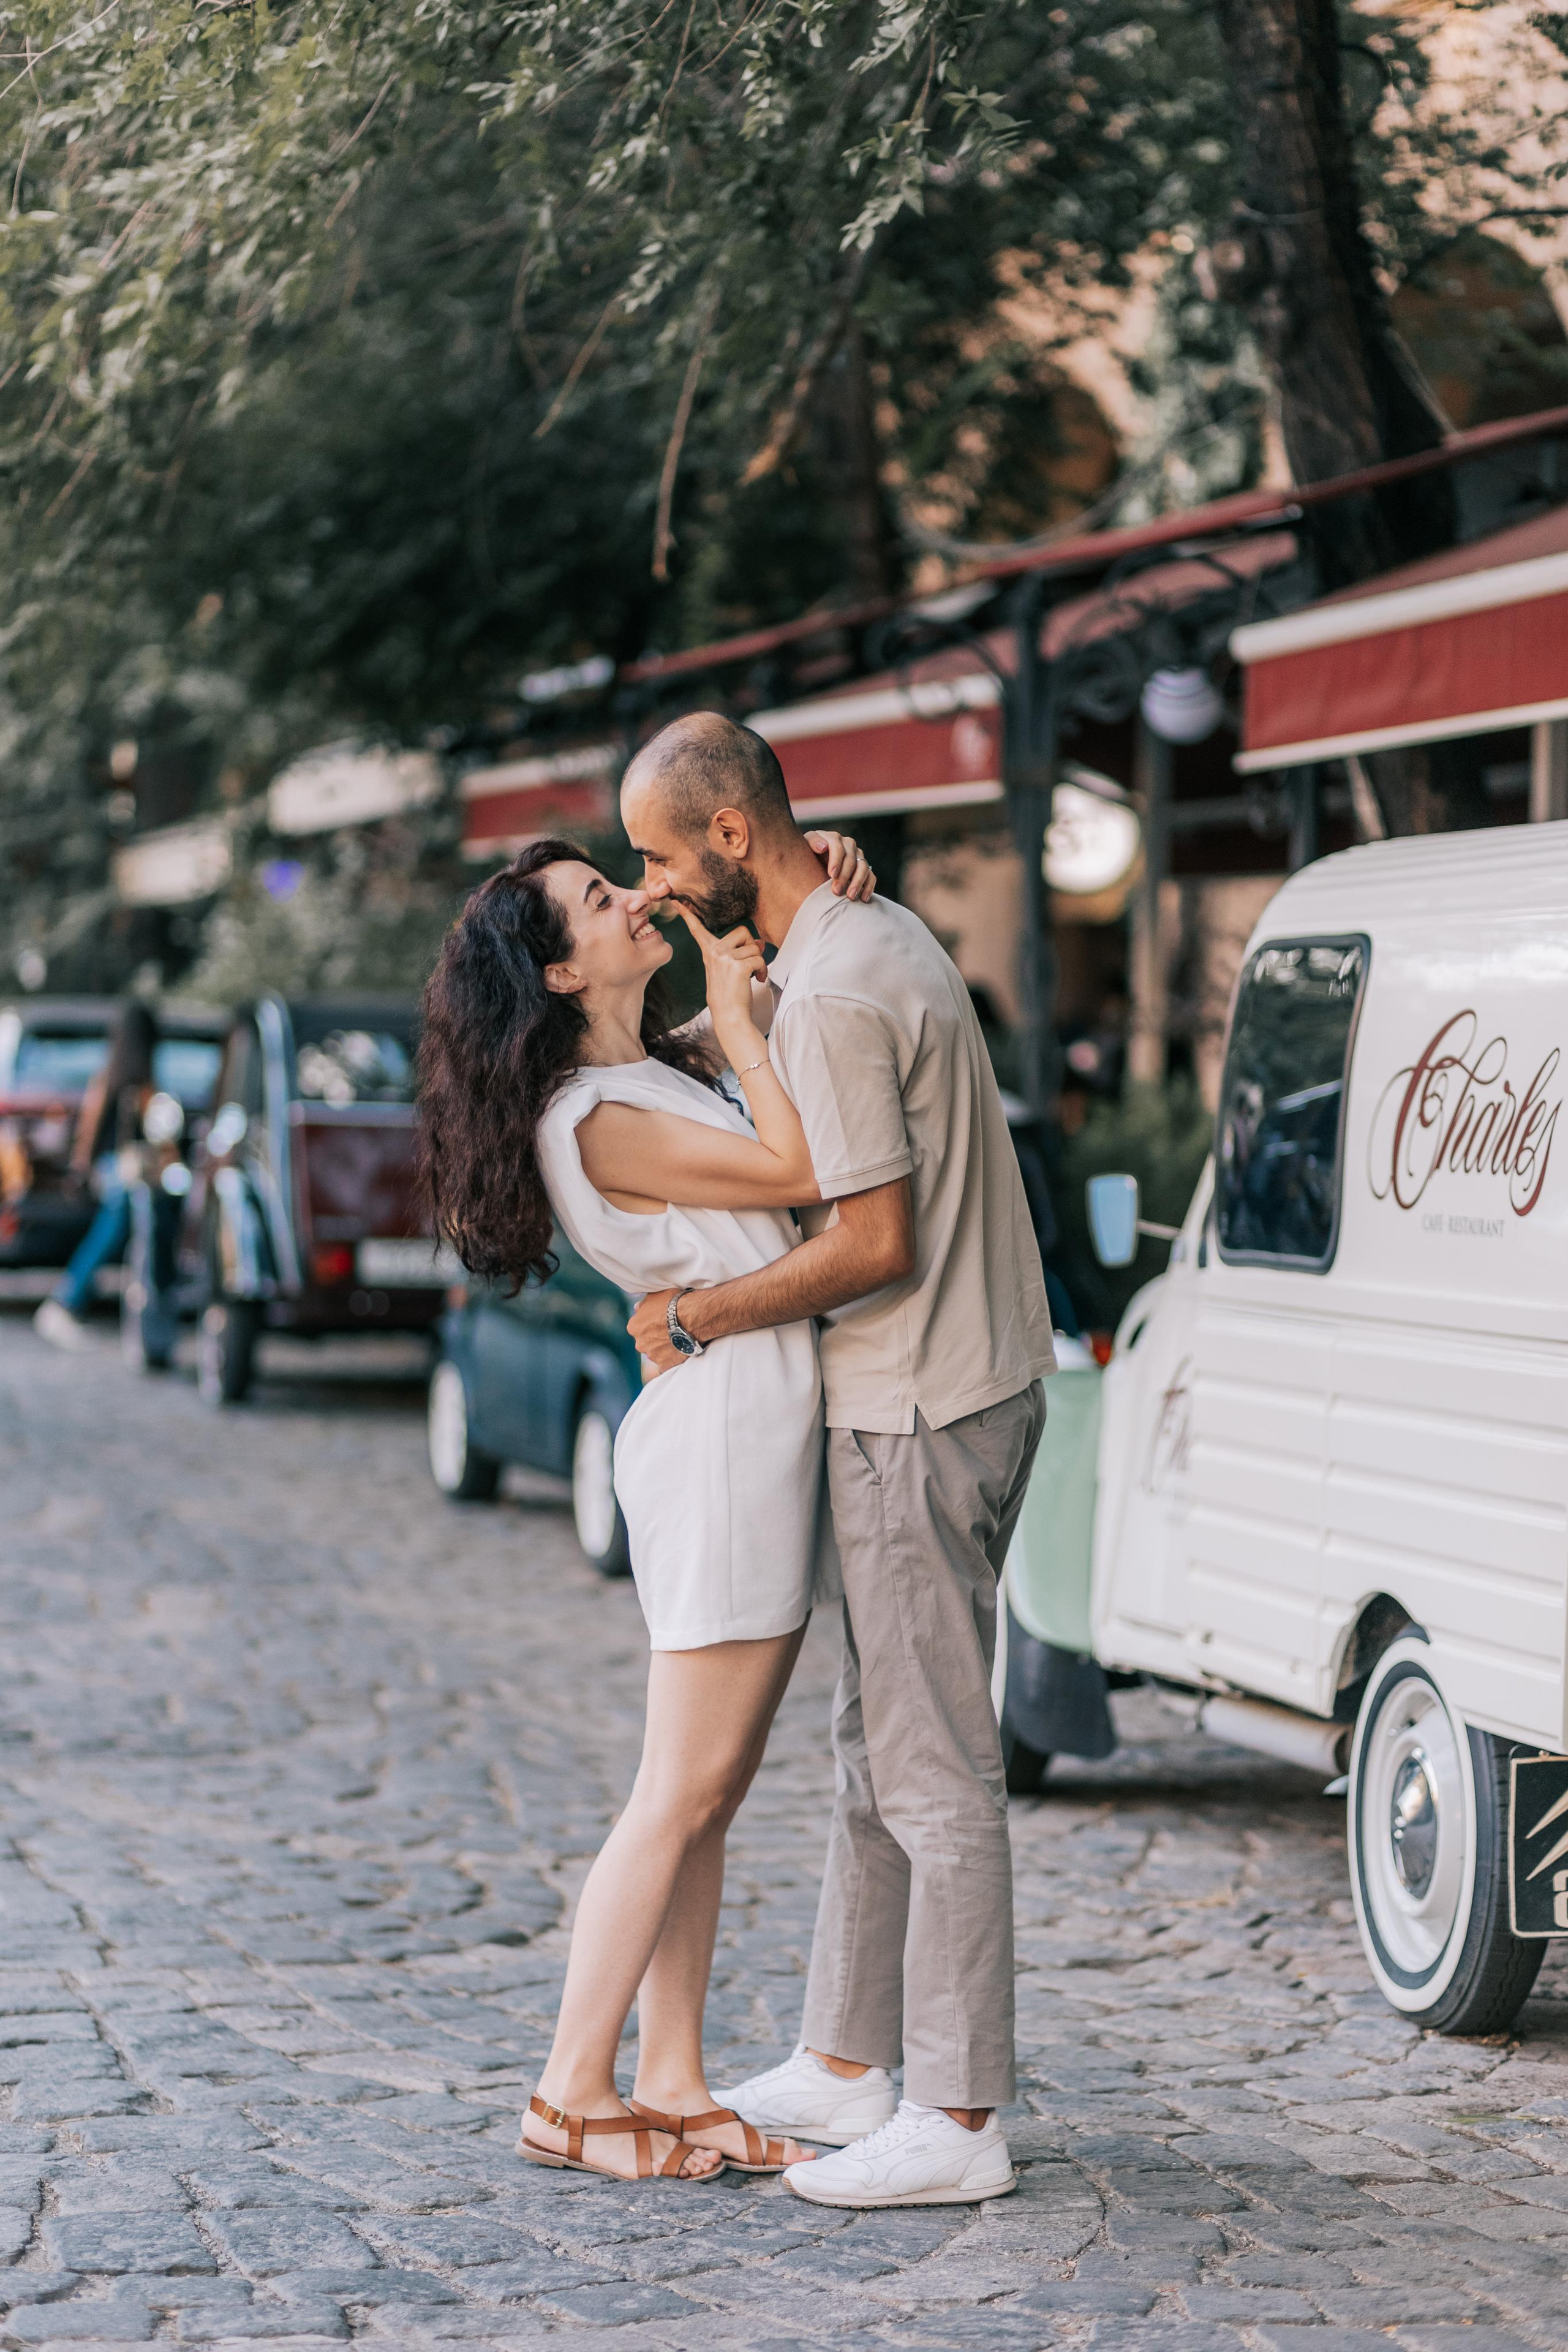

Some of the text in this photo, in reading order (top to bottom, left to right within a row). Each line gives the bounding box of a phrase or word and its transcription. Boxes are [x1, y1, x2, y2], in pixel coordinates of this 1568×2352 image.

[1367, 1008, 1562, 1216] Charles
[1448, 1215, 1506, 1237] RESTAURANT
[904, 2143, 928, 2155] PUMA
